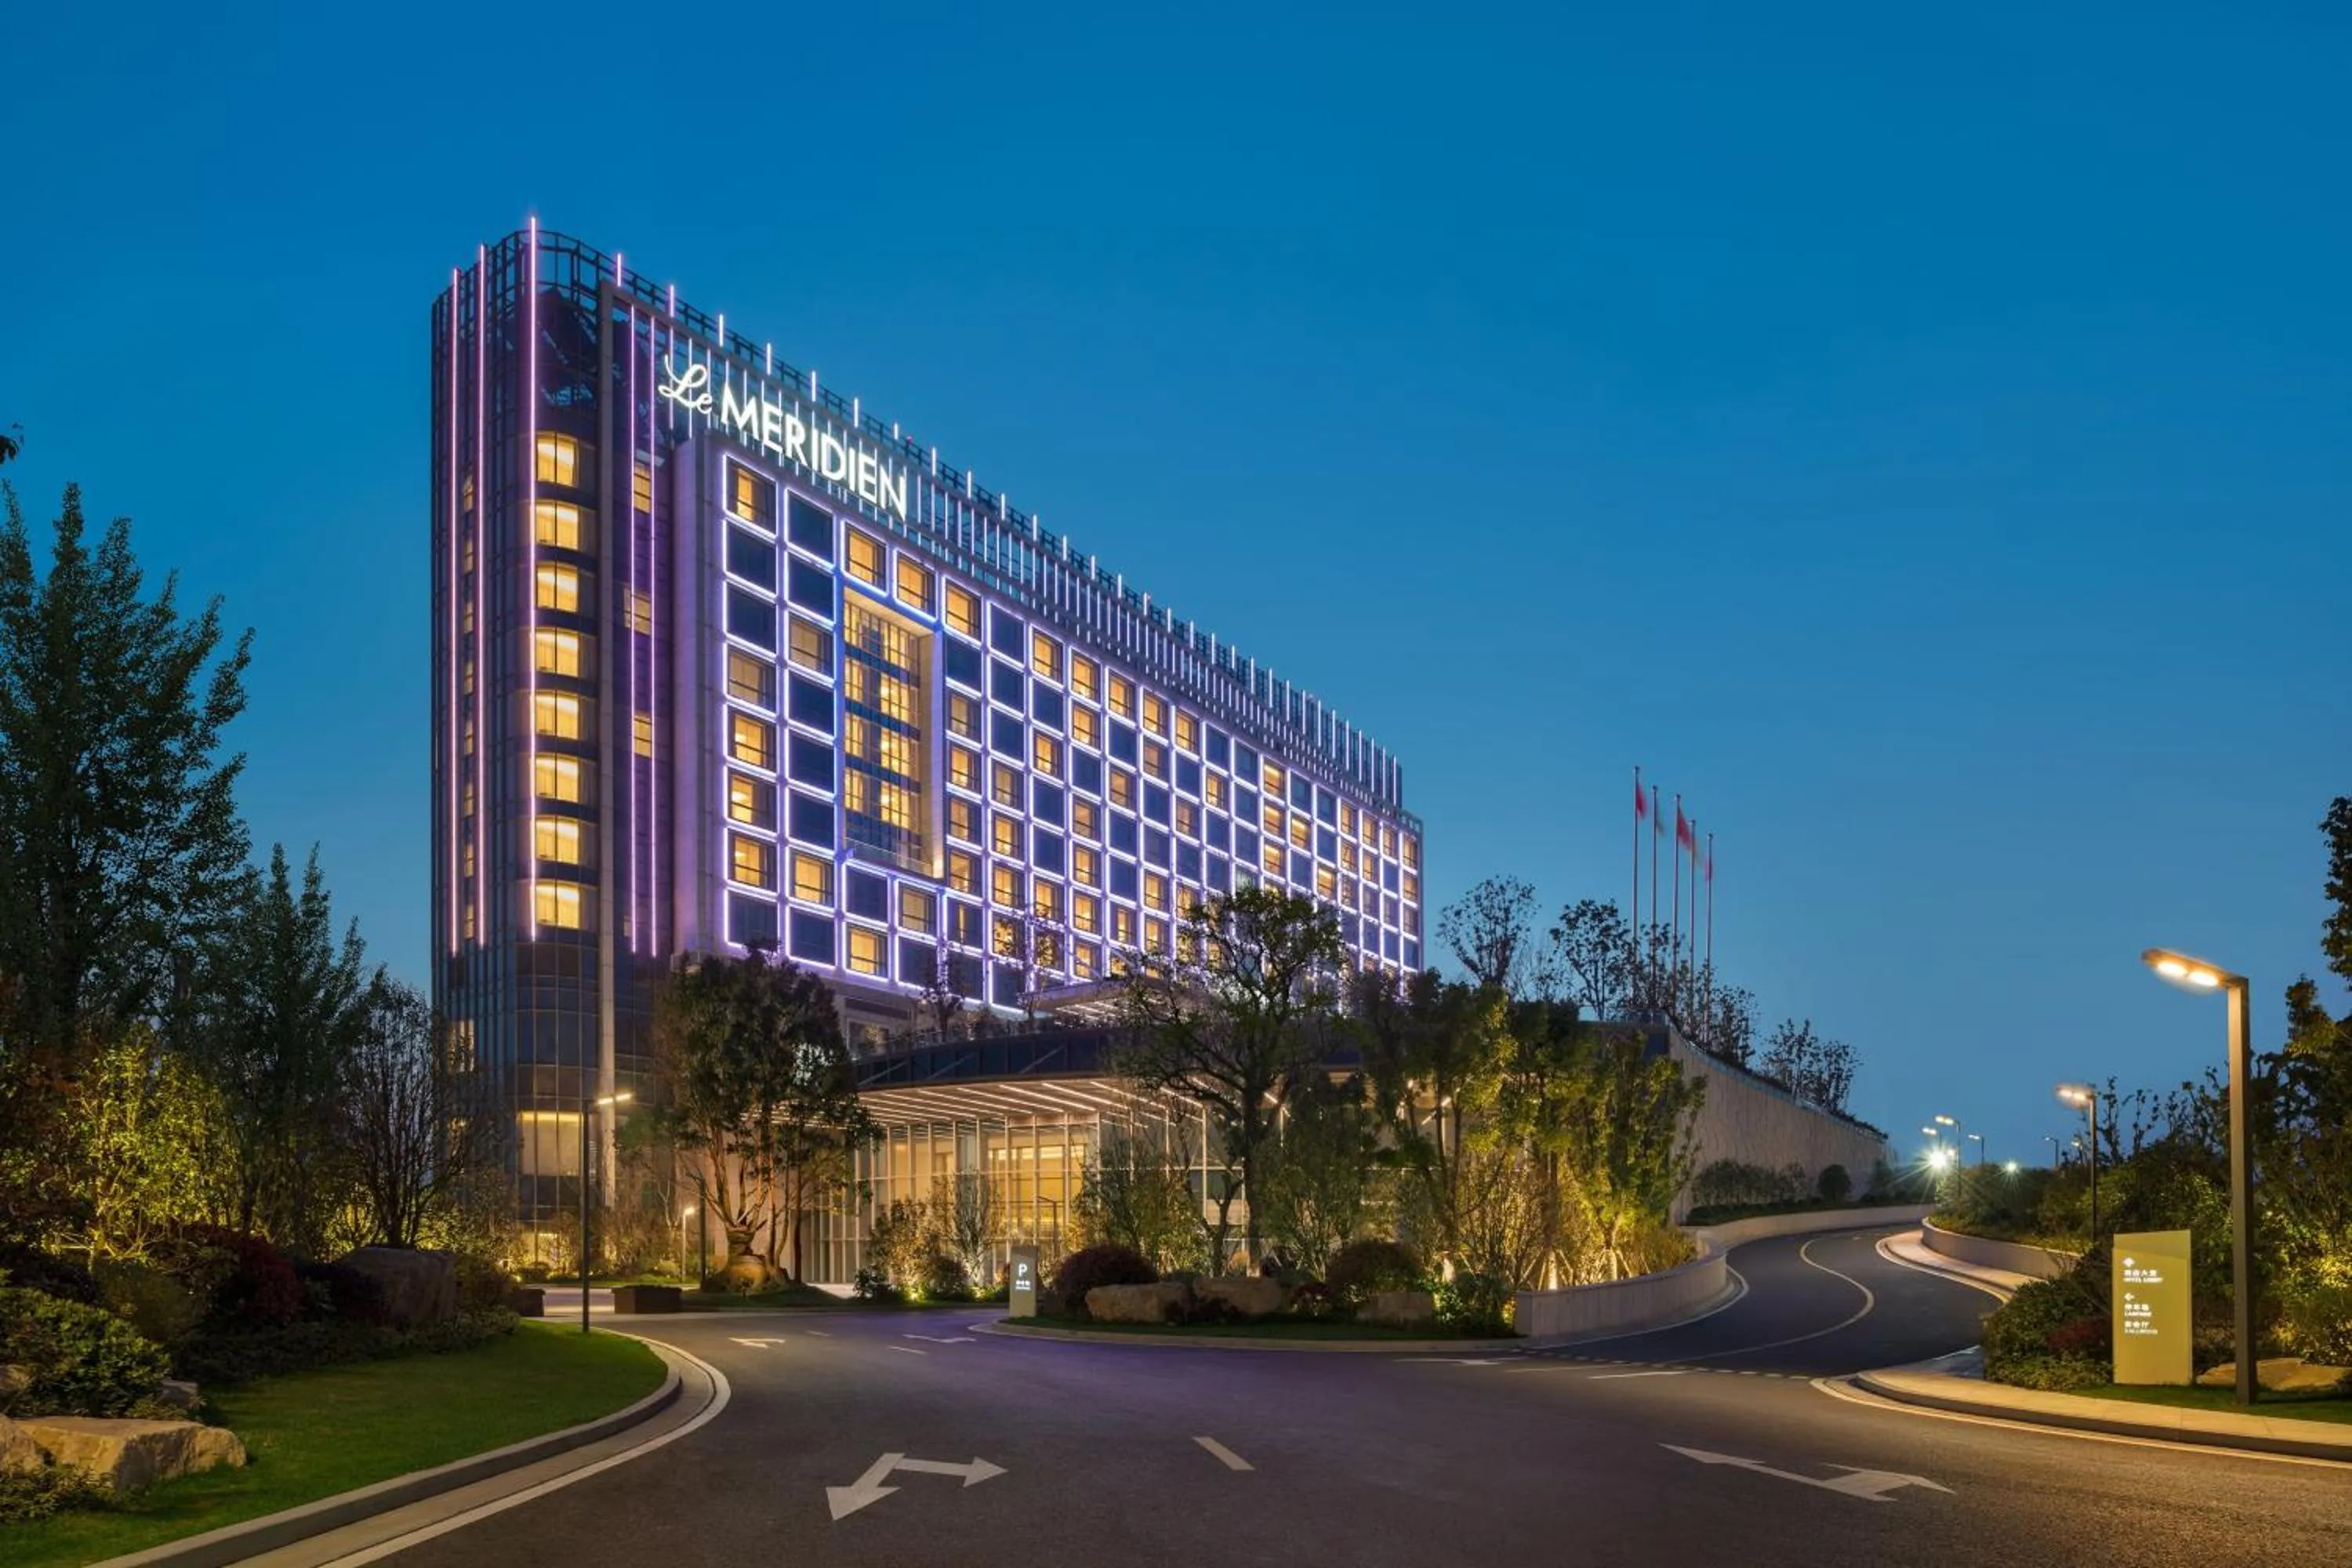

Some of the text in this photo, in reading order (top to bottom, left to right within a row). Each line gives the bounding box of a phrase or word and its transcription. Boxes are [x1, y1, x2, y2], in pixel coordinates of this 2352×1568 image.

[659, 354, 907, 521] Le MERIDIEN
[1018, 1263, 1028, 1277] P
